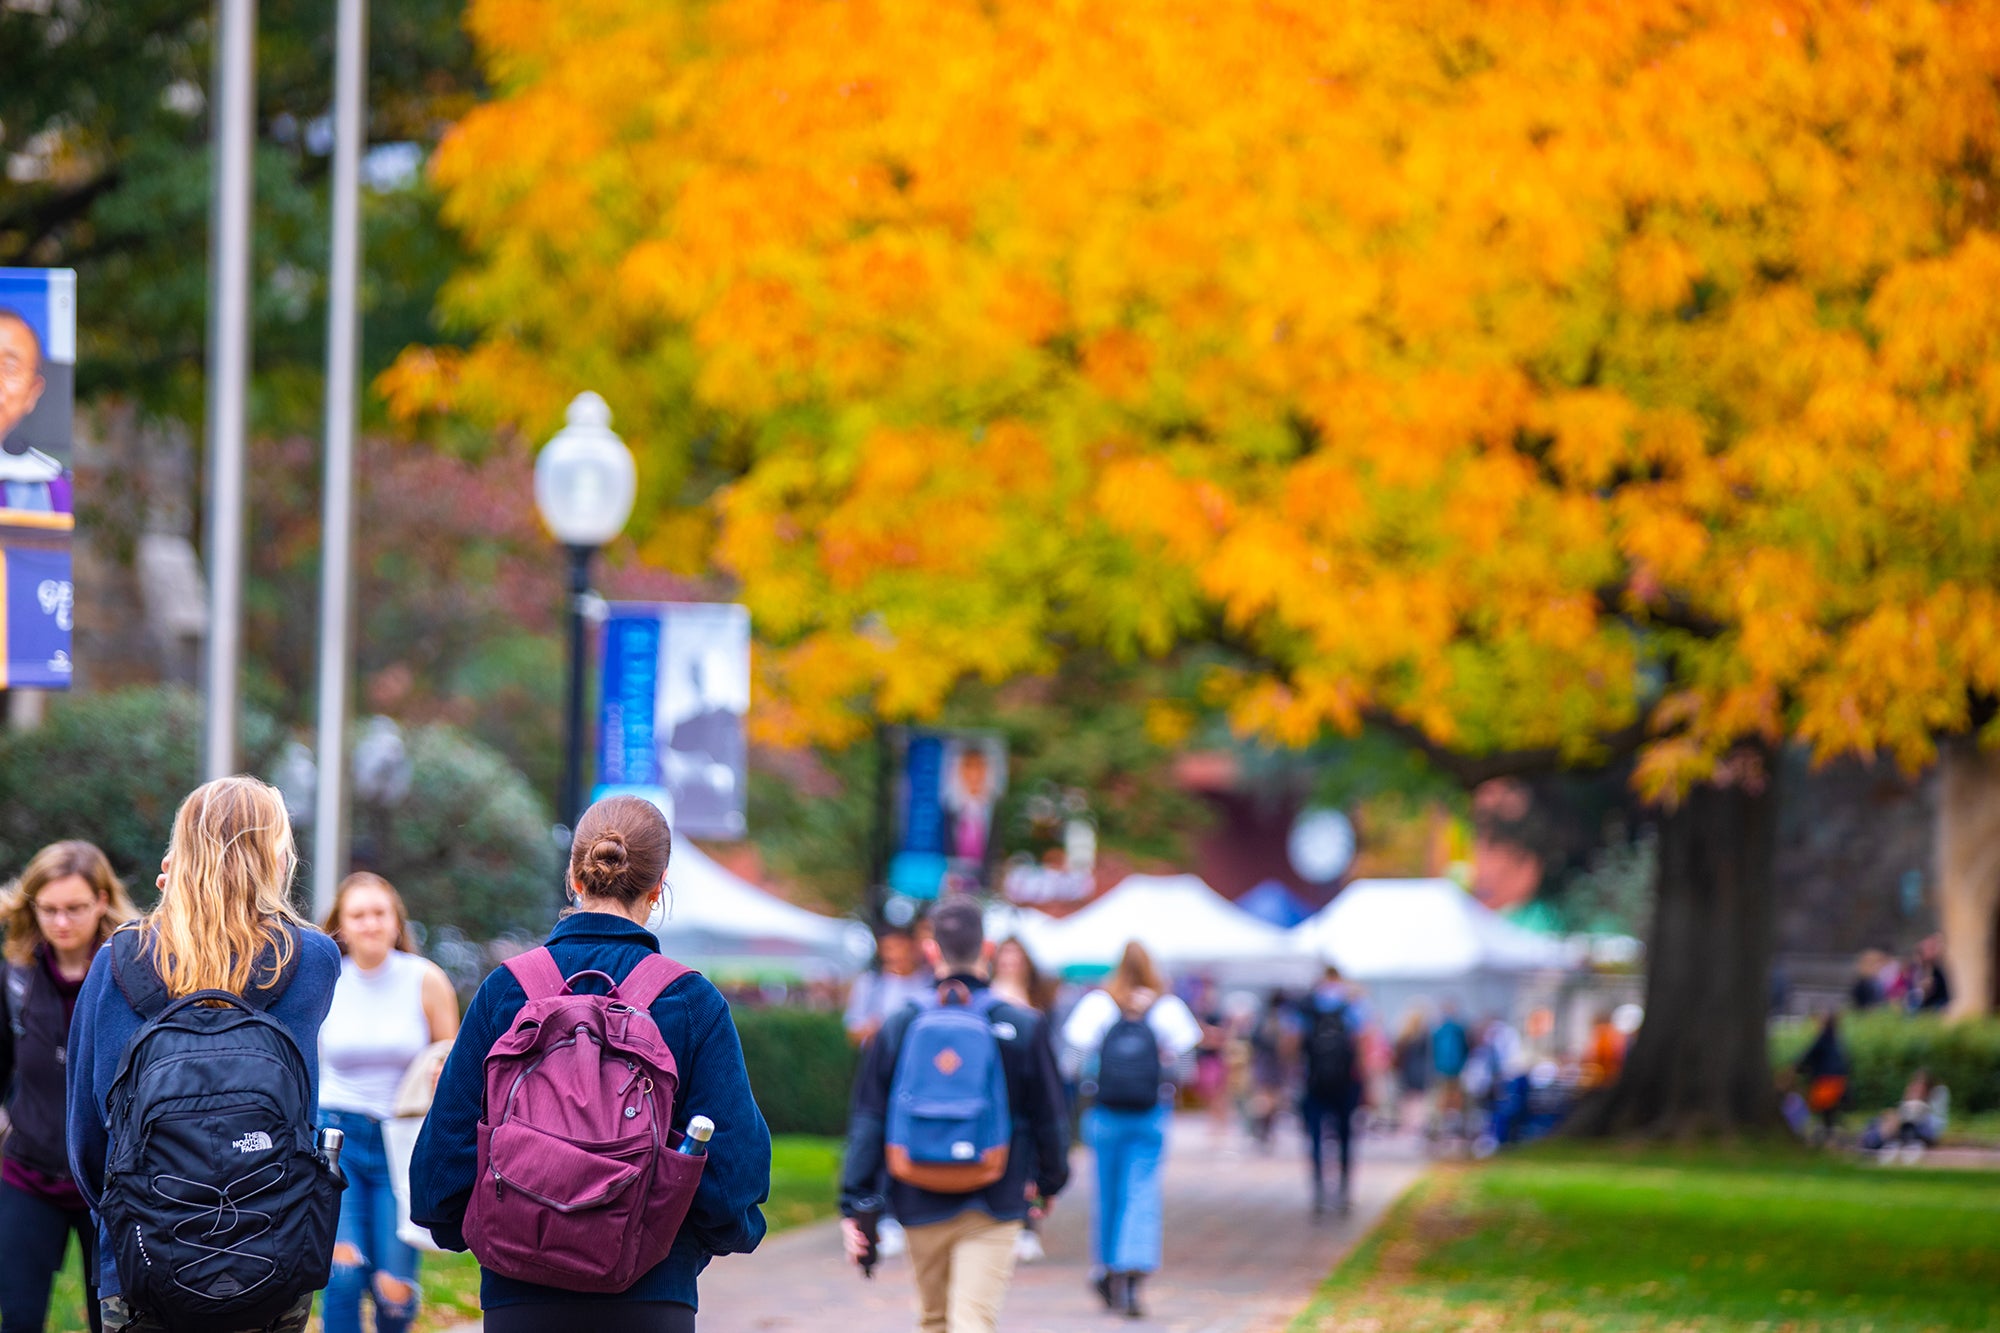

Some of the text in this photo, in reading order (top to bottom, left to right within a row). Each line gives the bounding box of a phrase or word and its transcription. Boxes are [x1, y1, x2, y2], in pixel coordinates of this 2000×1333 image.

[243, 1132, 259, 1140] THE
[232, 1138, 259, 1149] NORTH
[241, 1144, 261, 1153] FACE
